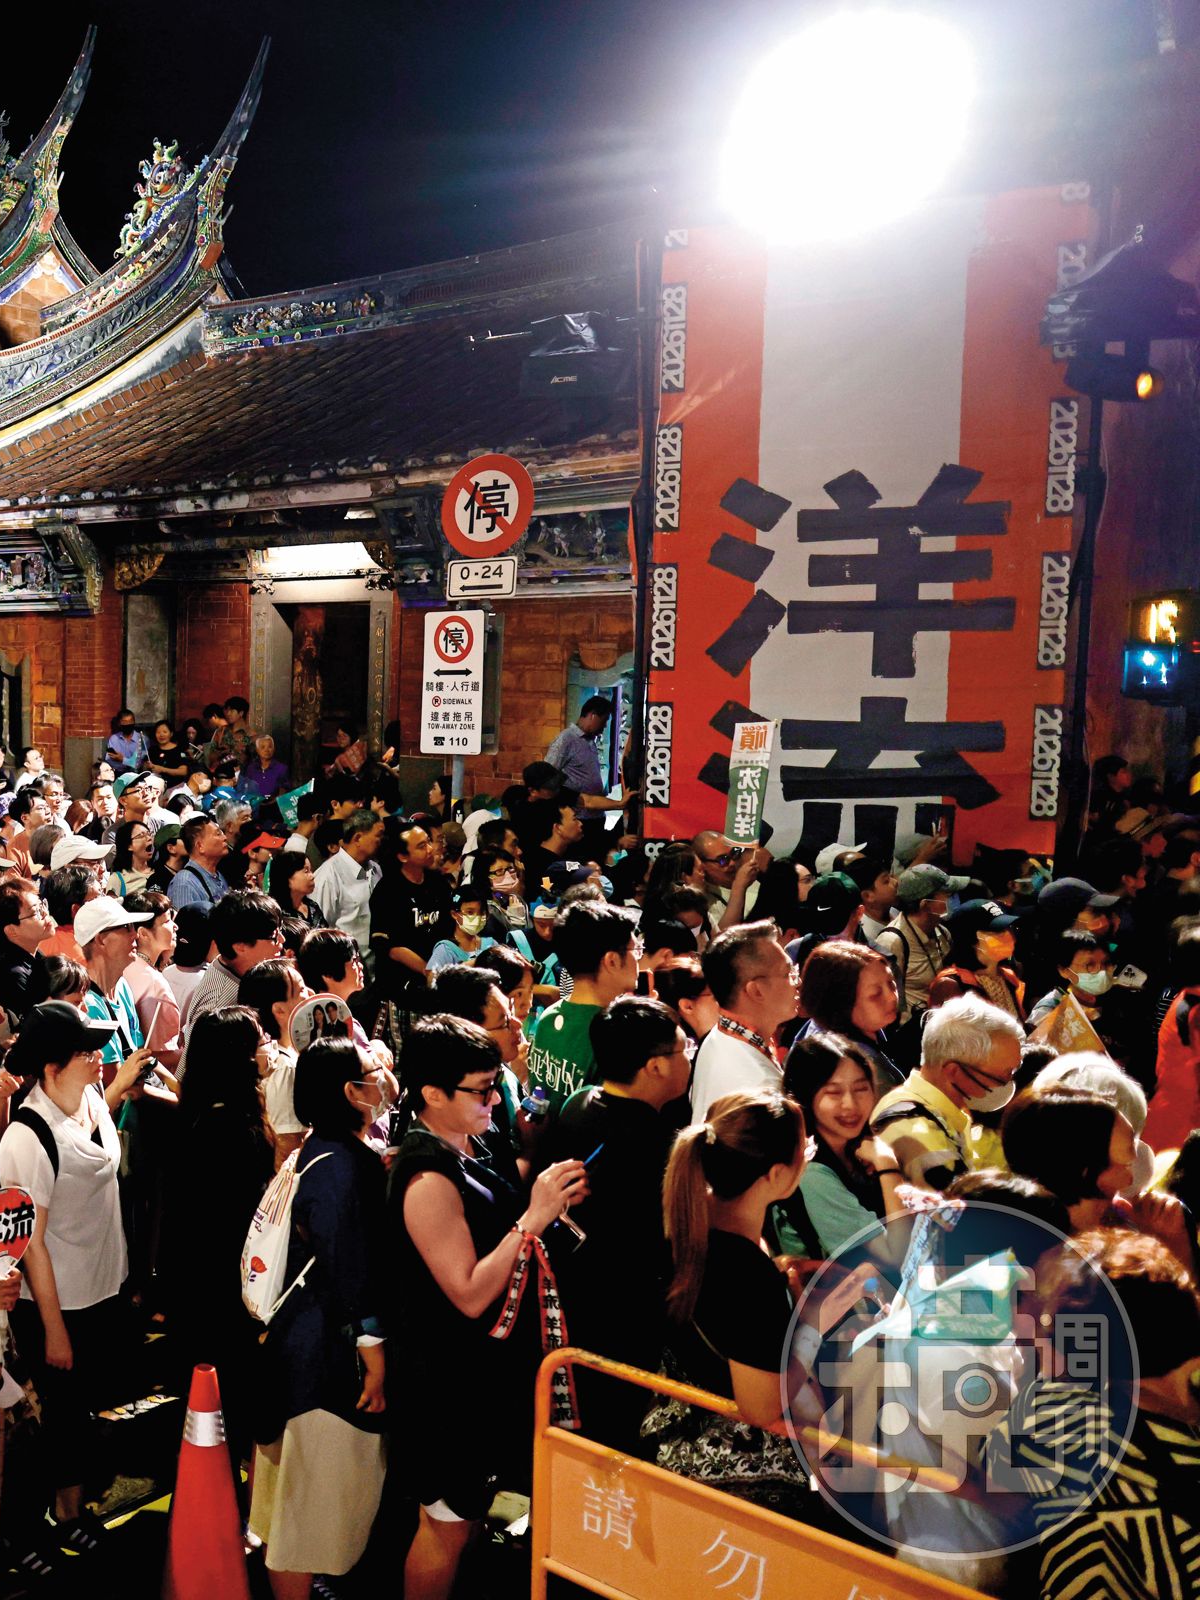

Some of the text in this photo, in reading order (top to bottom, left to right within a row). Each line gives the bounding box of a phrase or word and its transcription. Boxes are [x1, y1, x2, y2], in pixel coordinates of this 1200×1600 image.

[550, 376, 577, 384] ACME
[663, 286, 687, 390] 20261128
[464, 479, 510, 534] 停
[656, 427, 682, 528] 20261128
[1046, 401, 1078, 513] 20261128
[443, 627, 465, 653] 停
[651, 567, 677, 668] 20261128
[1037, 556, 1070, 666] 20261128
[697, 462, 1016, 868] 洋流
[427, 722, 458, 730] TOW-AWAY
[430, 711, 473, 722] 違者拖吊
[449, 737, 468, 746] 110
[645, 705, 672, 806] 20261128
[1029, 708, 1063, 817] 20261128
